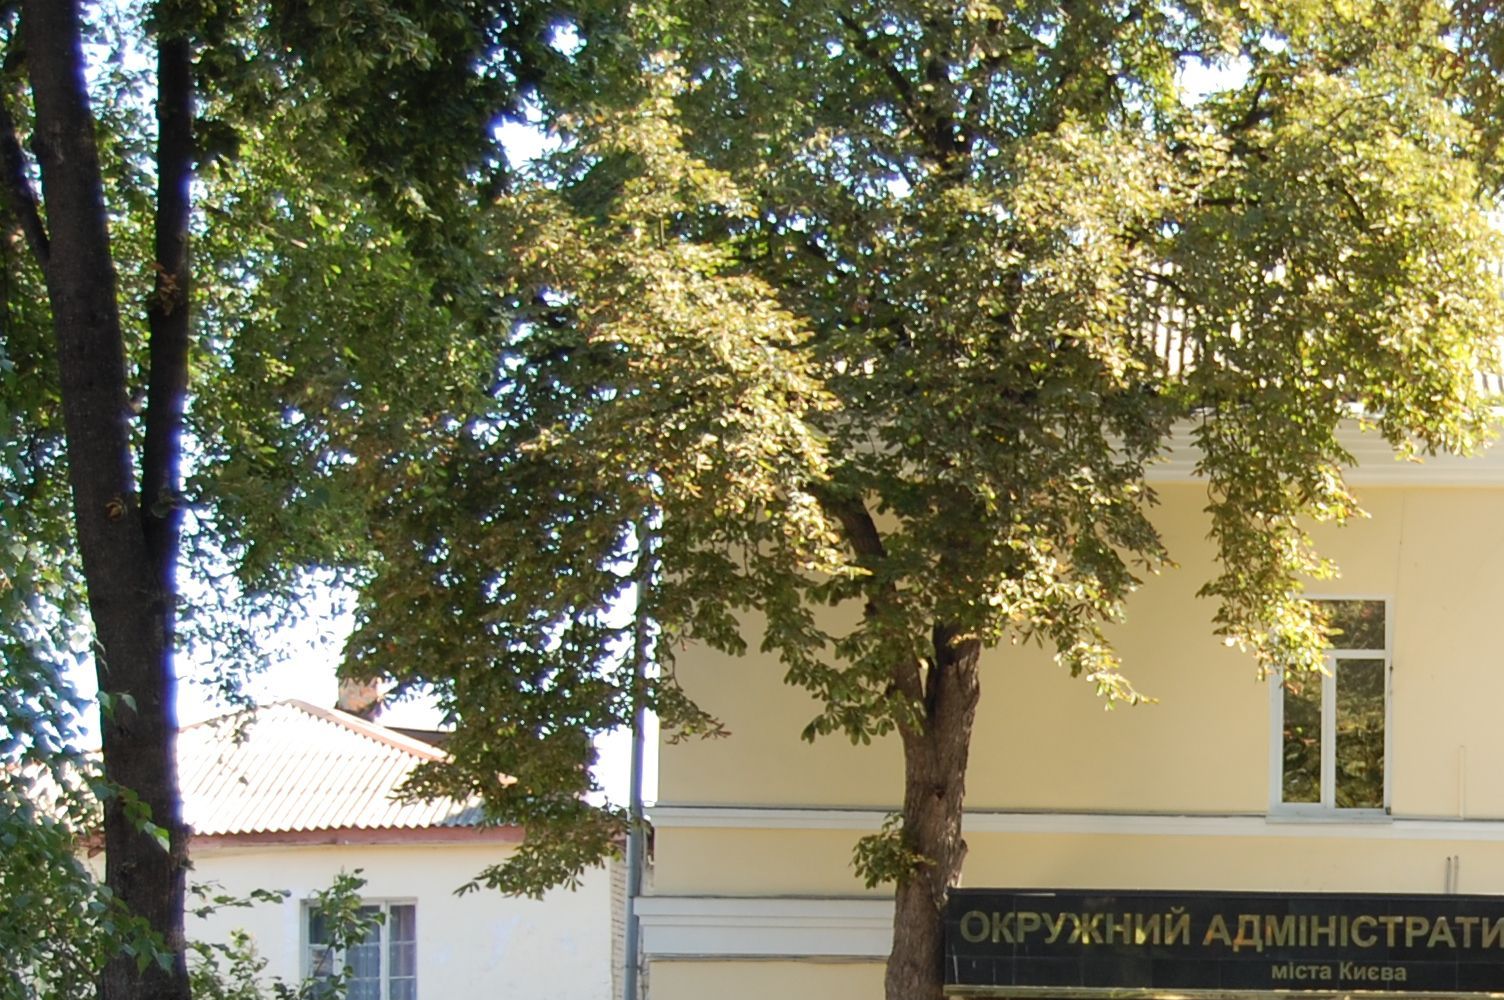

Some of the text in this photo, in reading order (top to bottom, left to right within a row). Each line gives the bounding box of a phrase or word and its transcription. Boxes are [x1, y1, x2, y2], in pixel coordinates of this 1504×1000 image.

[960, 906, 1191, 944] ОКРУЖНИЙ
[1271, 961, 1408, 983] міста Києва
